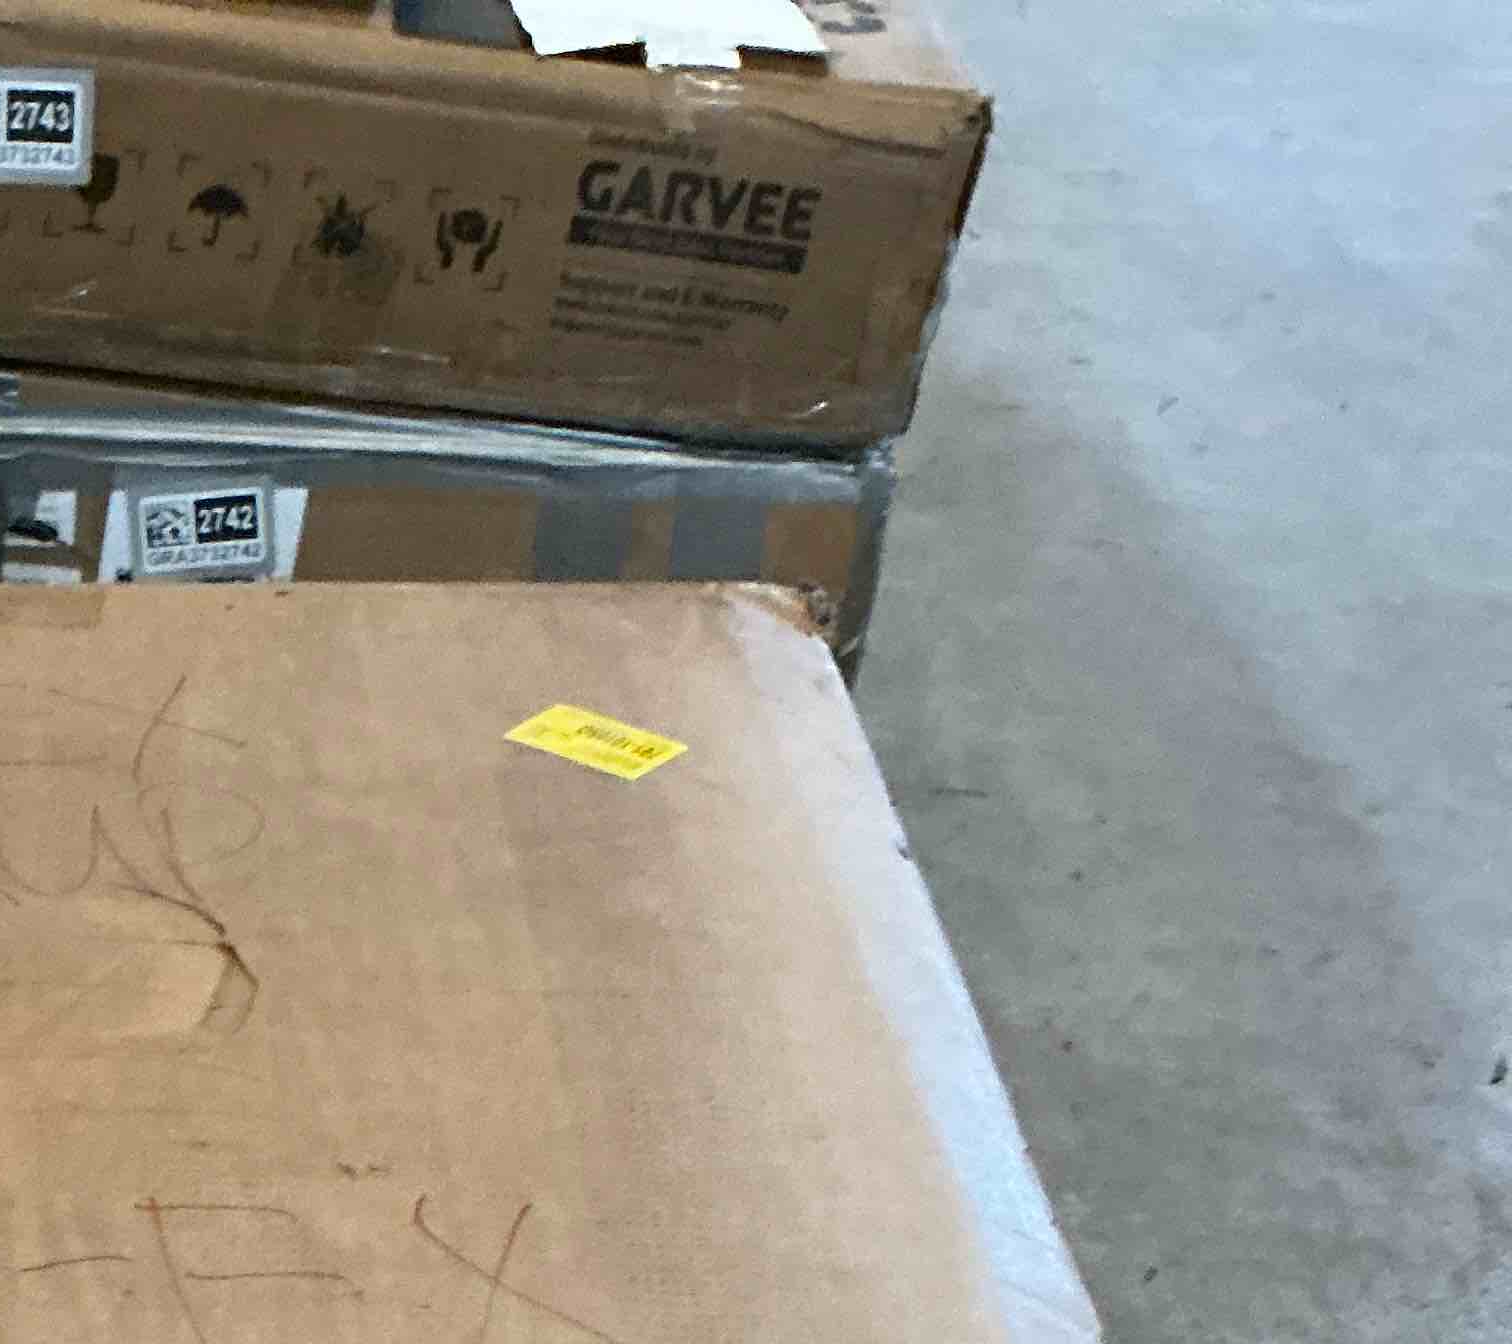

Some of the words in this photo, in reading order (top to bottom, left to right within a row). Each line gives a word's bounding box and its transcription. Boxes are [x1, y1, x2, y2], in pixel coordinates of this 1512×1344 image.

[9, 100, 71, 132] 2743
[576, 159, 824, 241] GARVEE
[197, 504, 253, 534] 2742
